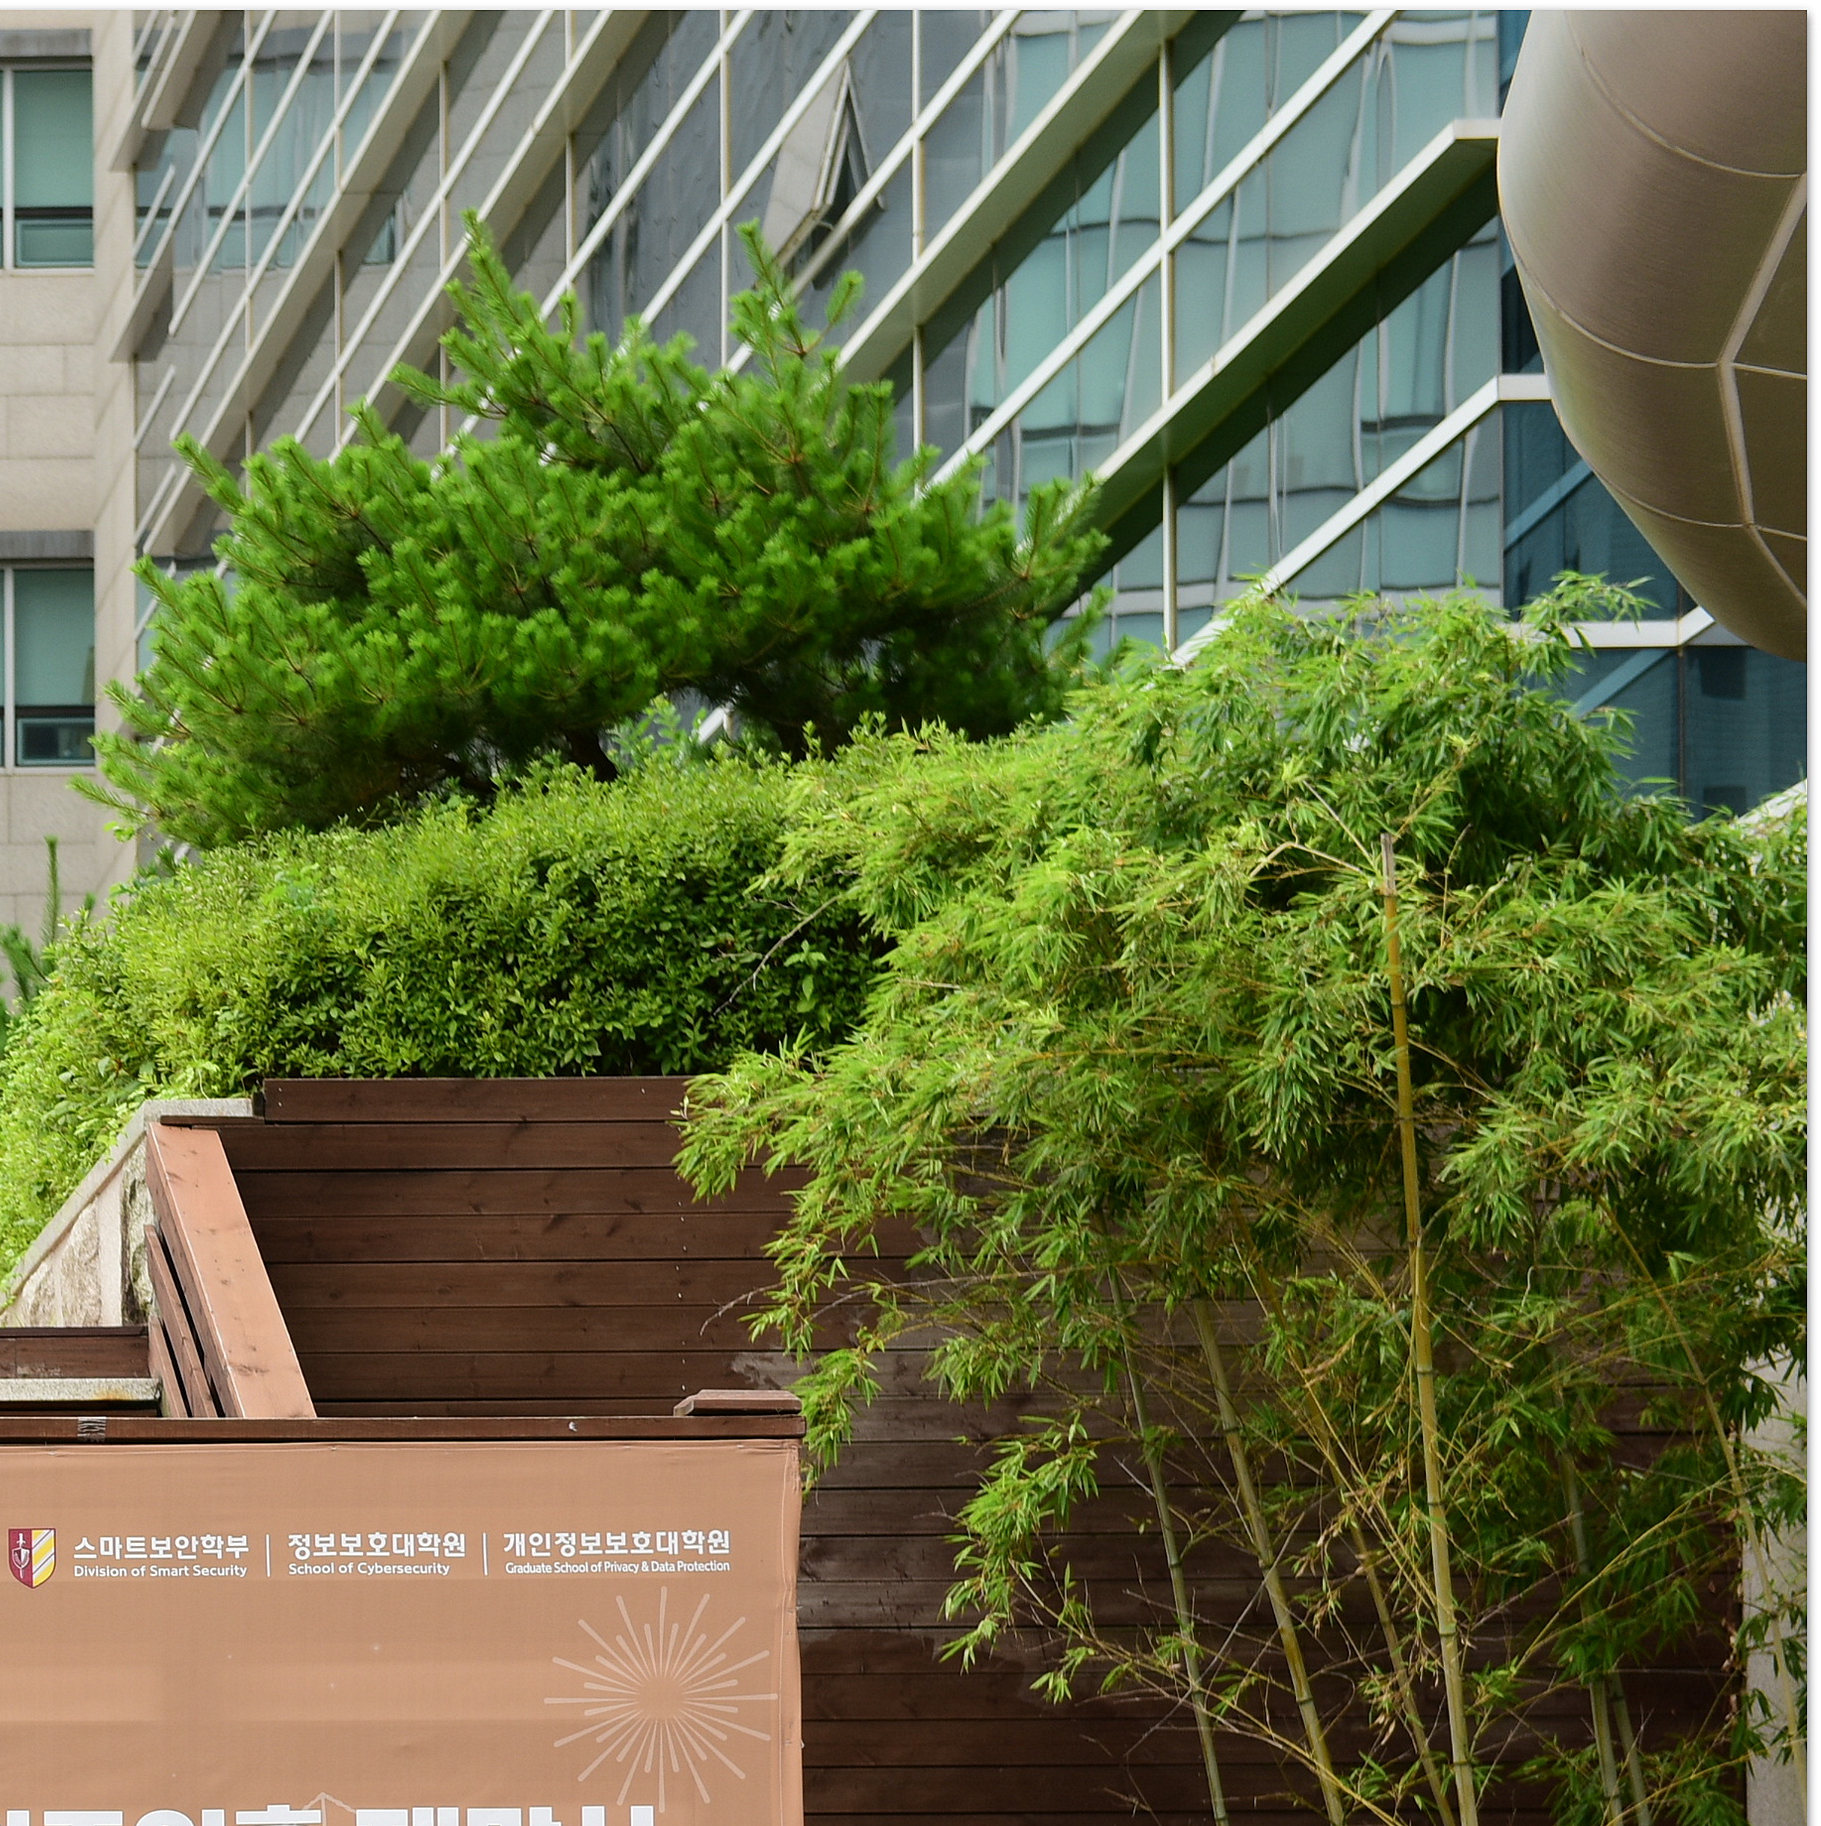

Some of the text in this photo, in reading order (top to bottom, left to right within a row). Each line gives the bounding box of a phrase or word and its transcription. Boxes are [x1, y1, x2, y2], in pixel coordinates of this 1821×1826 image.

[73, 1534, 249, 1560] 스마트보안학부
[288, 1531, 466, 1561] 정보보호대학원
[503, 1529, 730, 1558] 개인정보보호대학원
[74, 1564, 248, 1578] Division of Smart Security
[288, 1562, 450, 1576] School of Cybersecurity
[505, 1559, 731, 1574] Graduate School of Privacy & Data Protection
